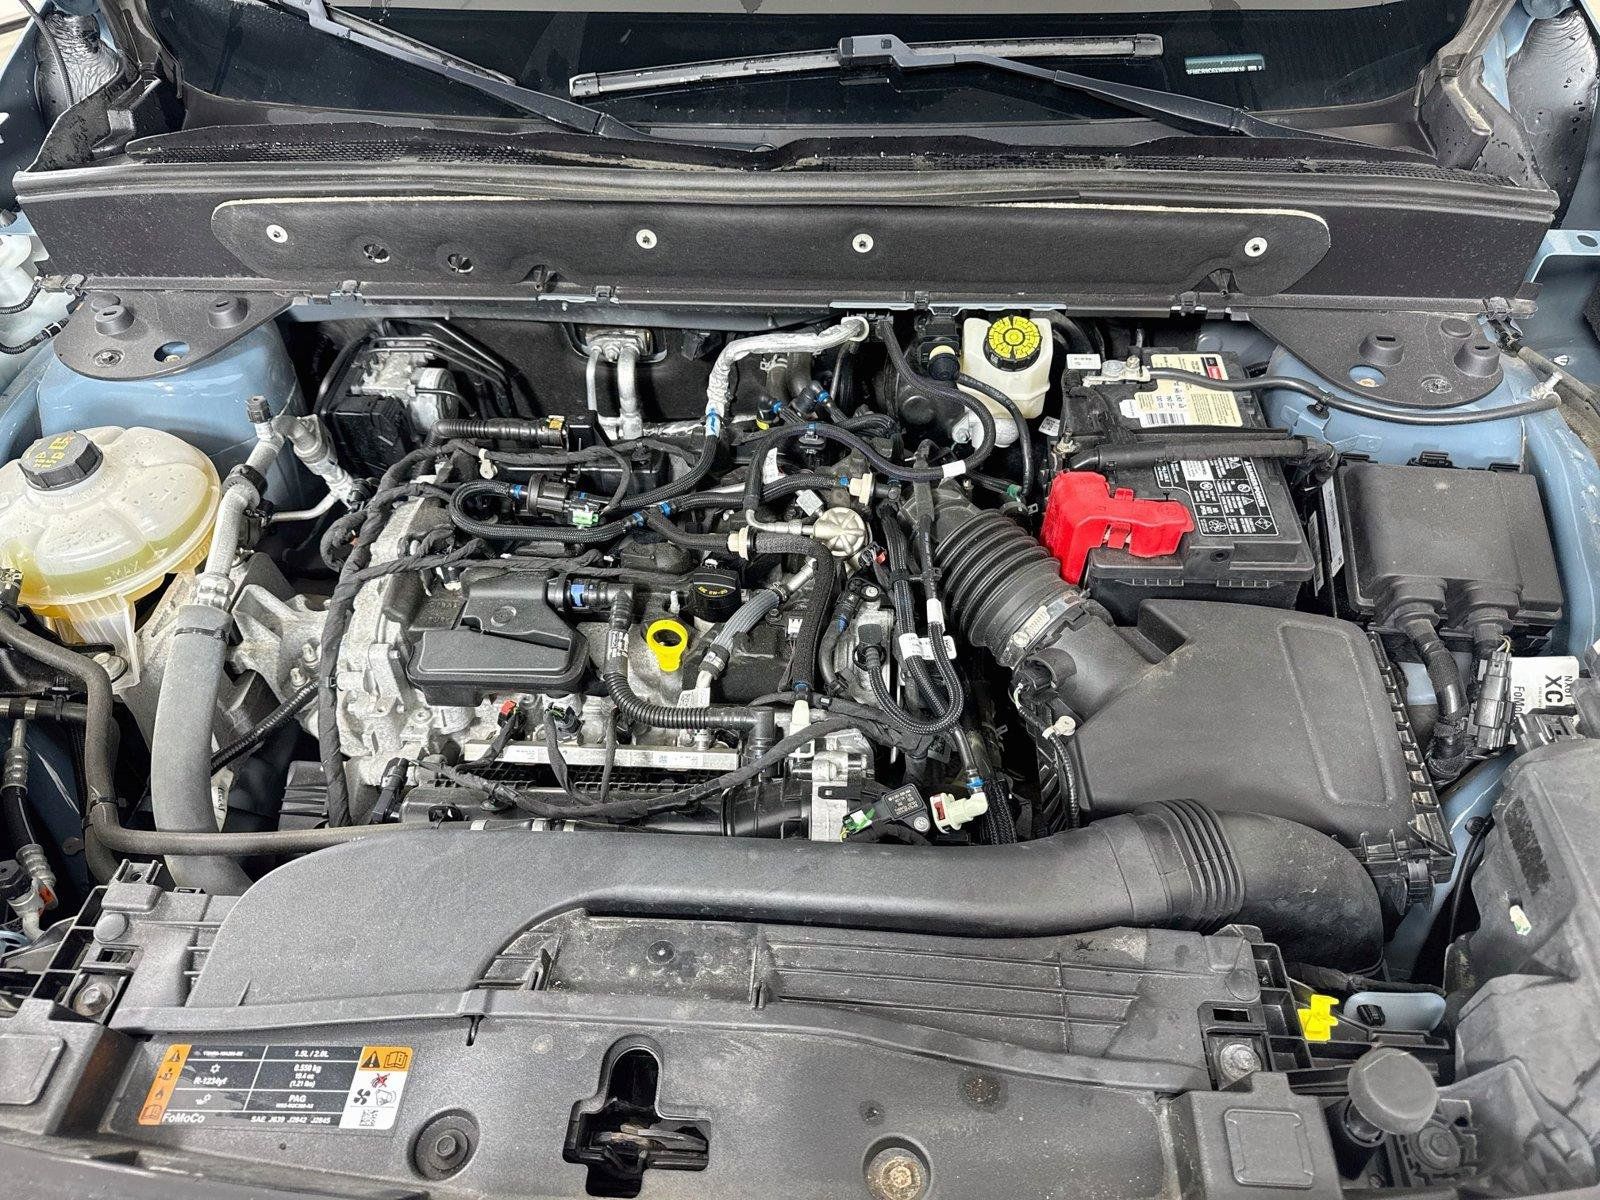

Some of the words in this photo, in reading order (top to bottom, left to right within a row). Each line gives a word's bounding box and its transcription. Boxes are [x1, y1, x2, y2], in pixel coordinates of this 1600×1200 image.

[1545, 675, 1563, 703] XC
[312, 1064, 322, 1074] kg
[193, 1076, 228, 1086] R-1234yf
[288, 1094, 307, 1103] PAG
[162, 1113, 206, 1123] FoMoCo
[250, 1115, 267, 1123] SAE
